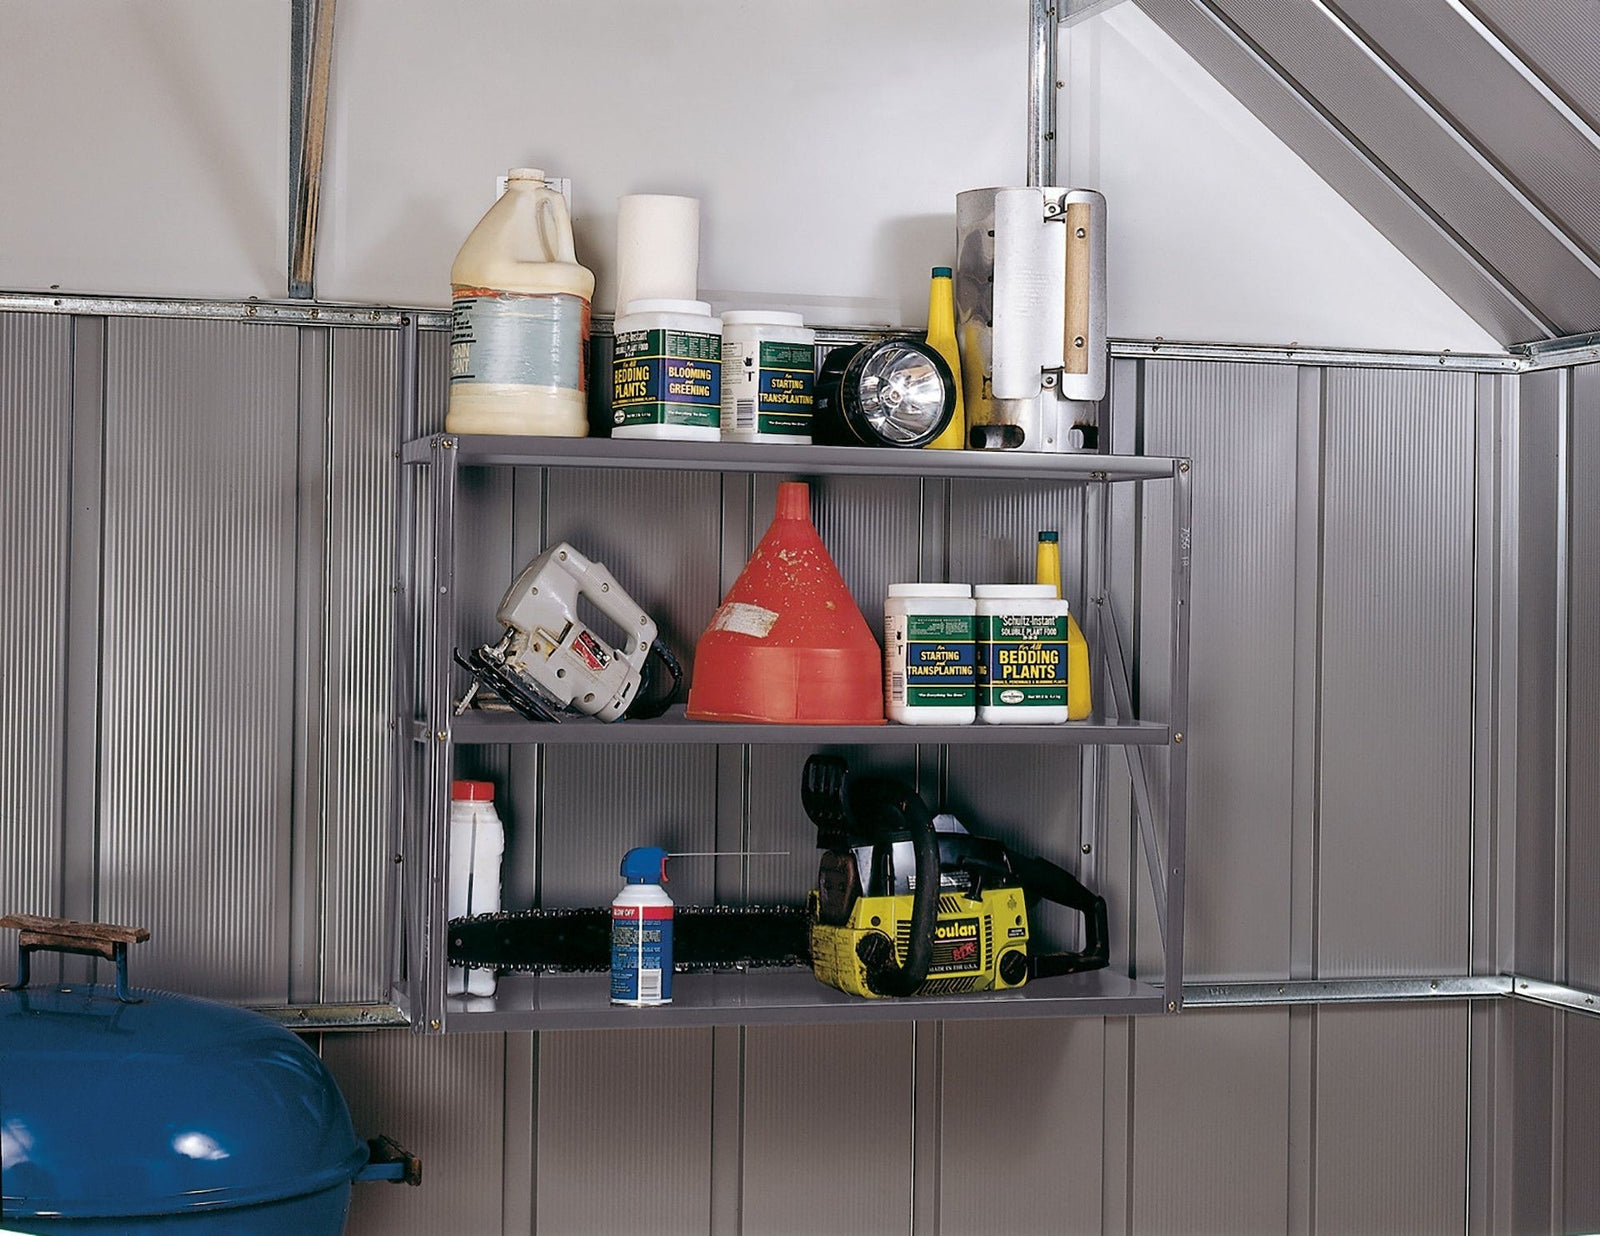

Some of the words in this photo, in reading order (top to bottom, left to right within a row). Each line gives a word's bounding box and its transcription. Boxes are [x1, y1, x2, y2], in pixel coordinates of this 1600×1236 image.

[614, 365, 650, 385] BEDDING
[668, 366, 712, 380] BLOOMING
[615, 381, 647, 399] PLANTS
[669, 383, 710, 396] GREENING
[771, 378, 804, 390] STARTING
[759, 393, 814, 405] TRANSPLANTING
[1026, 627, 1043, 636] PLANT
[1043, 627, 1057, 636] FOOD
[921, 651, 959, 661] STARTING
[999, 650, 1059, 664] BEDDING
[907, 666, 973, 675] TRANSPLANTING
[1003, 665, 1056, 679] PLANTS
[625, 908, 635, 916] OFF
[936, 922, 977, 938] oulan
